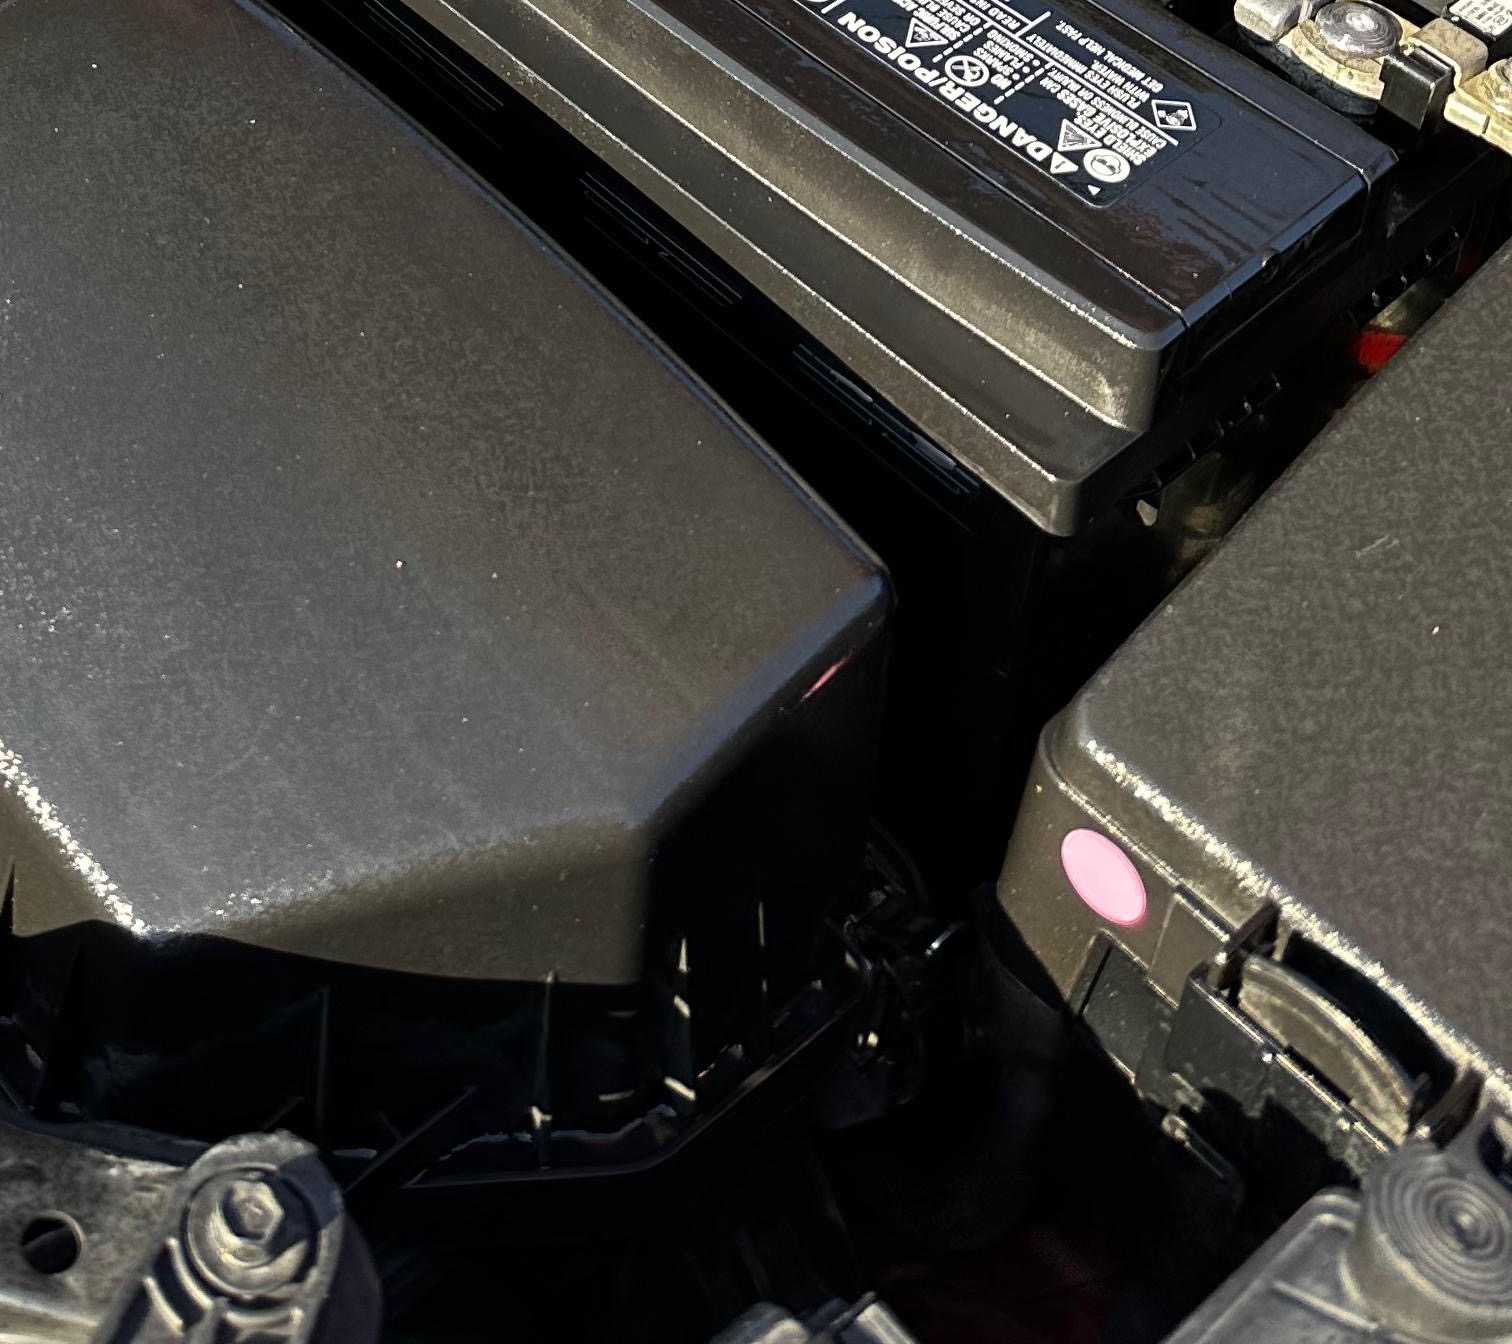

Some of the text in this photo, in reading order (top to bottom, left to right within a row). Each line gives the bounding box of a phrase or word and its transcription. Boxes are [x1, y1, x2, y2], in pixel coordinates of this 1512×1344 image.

[911, 7, 962, 40] SULFURIC
[935, 8, 971, 32] CAUSE
[961, 12, 982, 25] OR
[986, 6, 1021, 29] READ
[971, 47, 1015, 75] SPARKS
[981, 40, 1025, 68] FLAMES
[985, 29, 1035, 61] SMOKING
[1052, 20, 1164, 92] GET MEDICAL HELP FAST.
[987, 72, 1013, 89] NO
[1025, 32, 1141, 108] FLUSH EYES IMMEDIATELY
[1087, 59, 1151, 101] WITH WATER.
[833, 12, 1055, 161] DANGER/POISON
[1038, 77, 1158, 156] EXPLOSIVE GASES CAN
[1045, 67, 1168, 148] CAUSE BLINDNESS OR INJURY.
[1100, 133, 1148, 165] SHIELD
